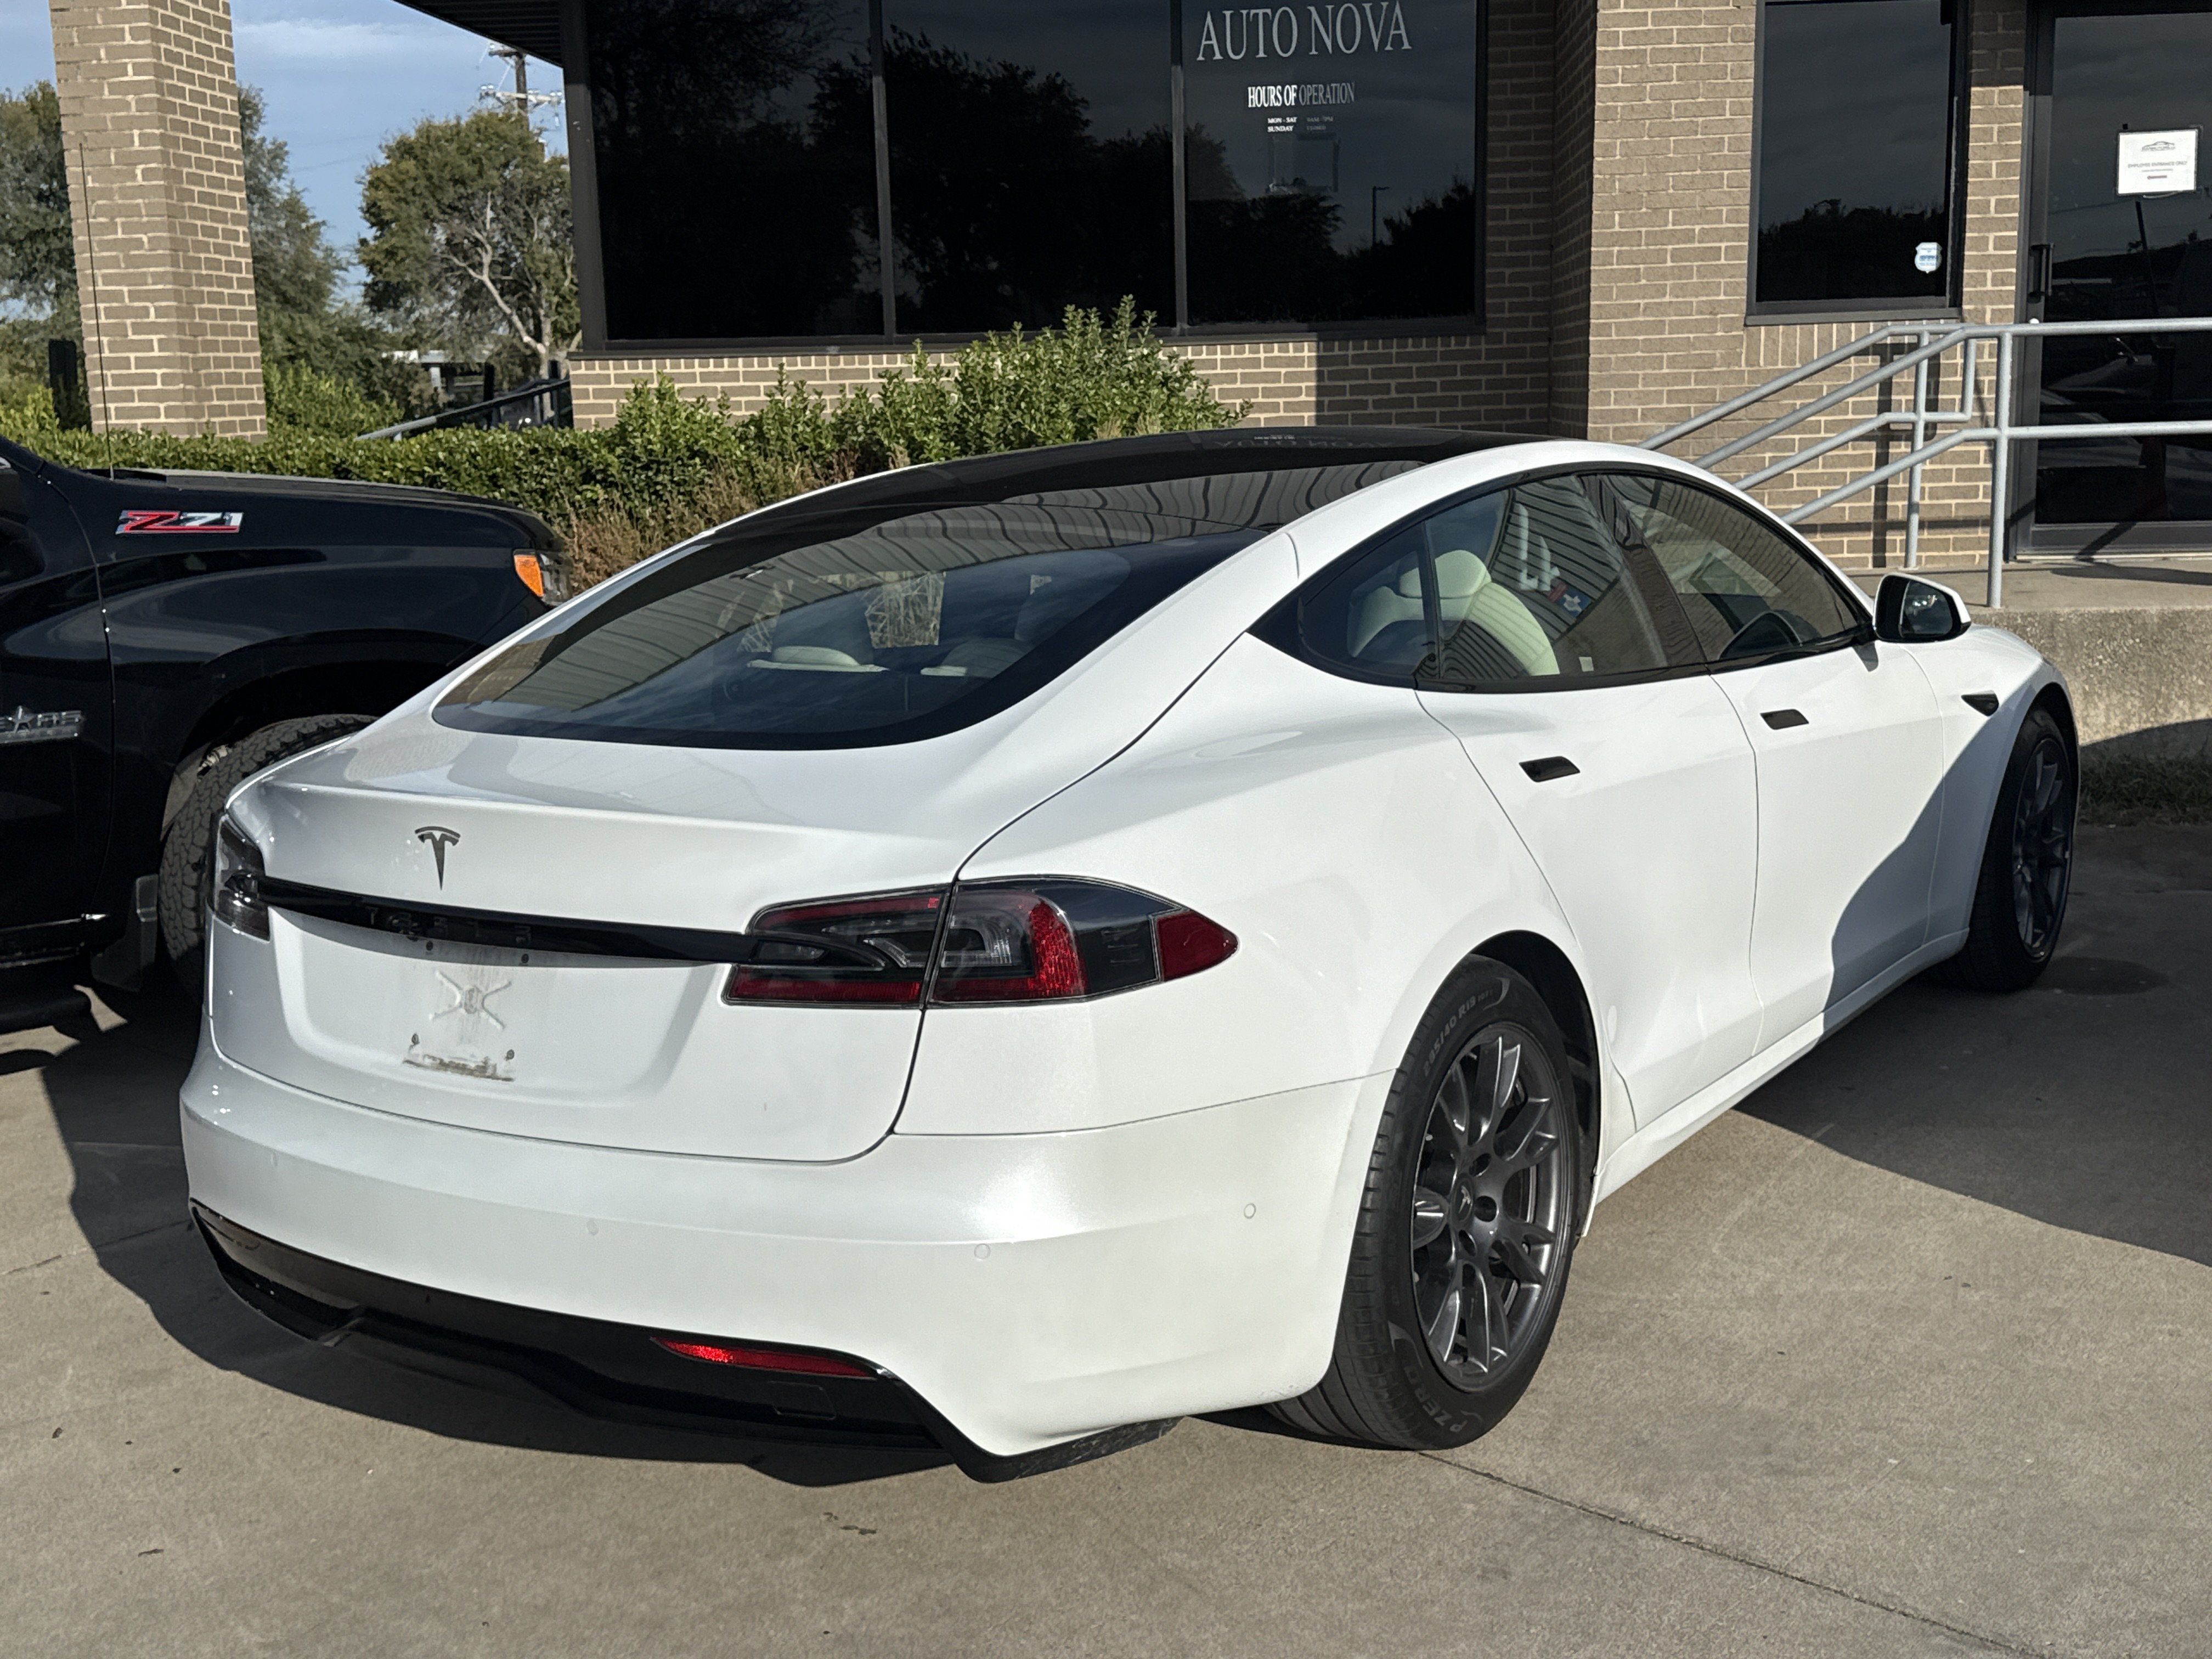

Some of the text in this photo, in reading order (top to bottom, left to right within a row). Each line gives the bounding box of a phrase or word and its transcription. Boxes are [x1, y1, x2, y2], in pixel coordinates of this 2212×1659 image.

[1197, 1, 1412, 60] AUTO NOVA
[1248, 82, 1355, 108] HOURS OF OPERATION
[115, 510, 244, 534] Z71
[1404, 1366, 1453, 1426] ZERO
